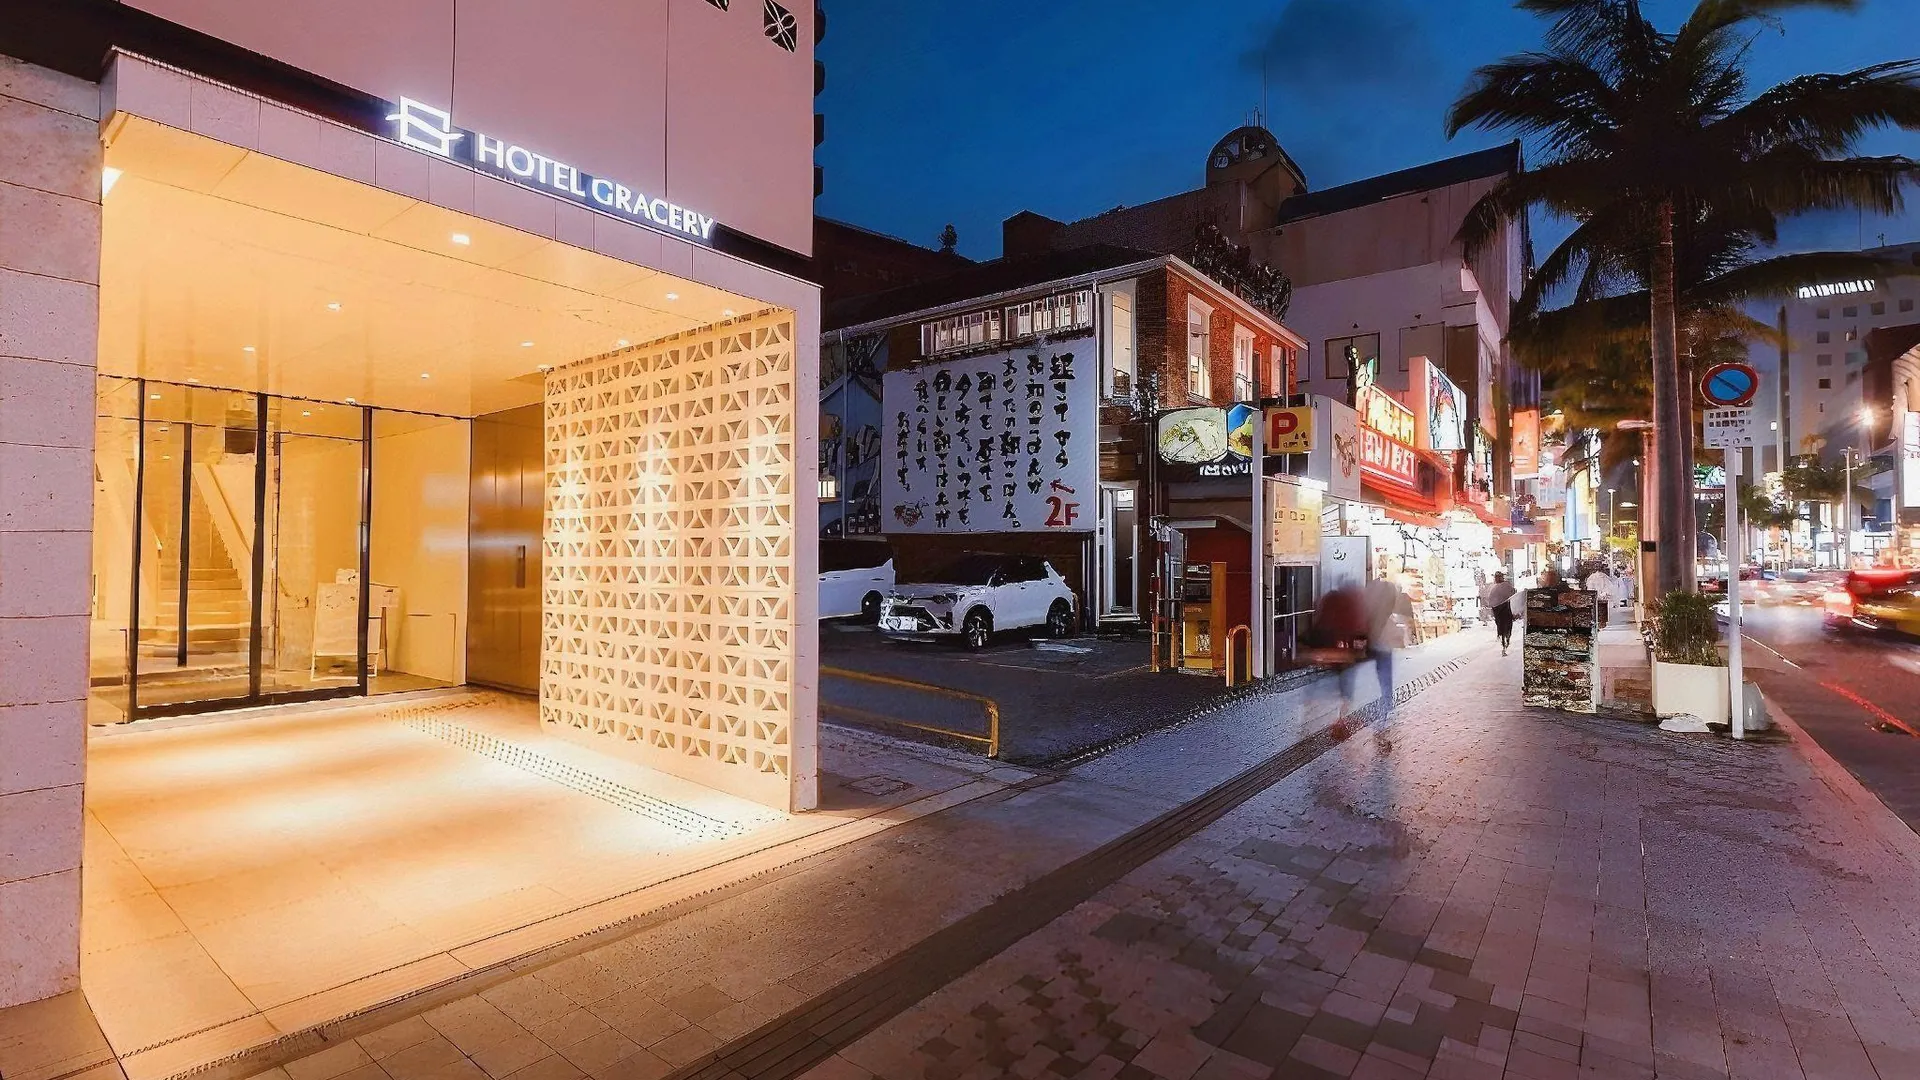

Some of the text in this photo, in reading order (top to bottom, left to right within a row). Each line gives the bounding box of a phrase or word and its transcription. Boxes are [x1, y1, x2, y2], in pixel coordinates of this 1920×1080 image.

[478, 133, 714, 240] HOTEL GRACERY
[1271, 412, 1298, 449] P
[1044, 496, 1081, 527] 2F
